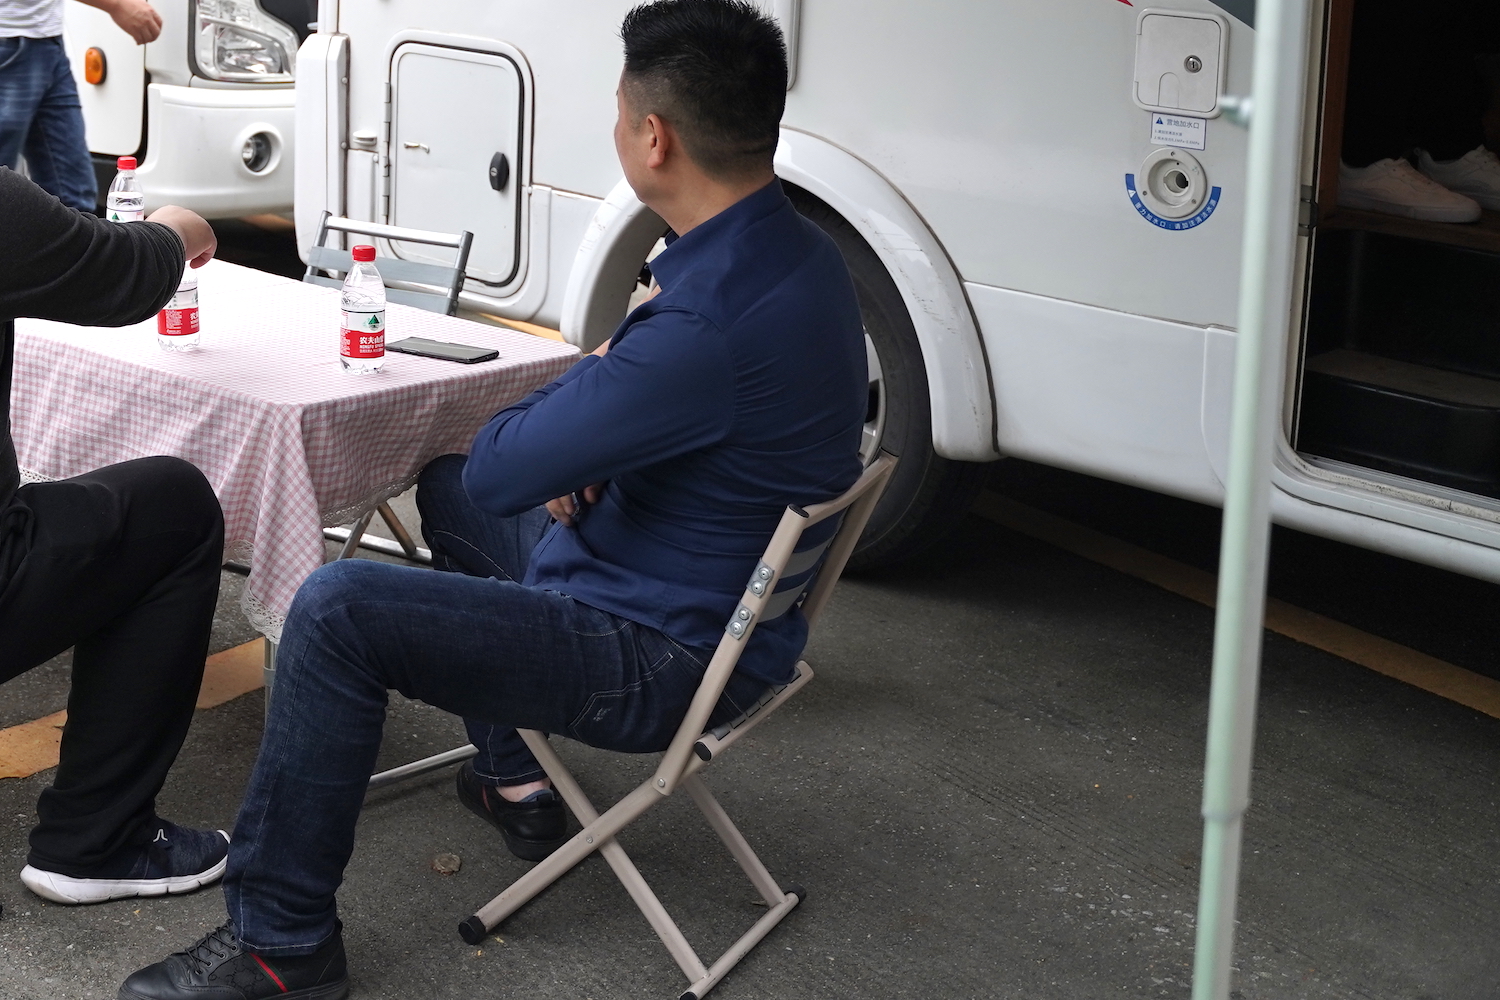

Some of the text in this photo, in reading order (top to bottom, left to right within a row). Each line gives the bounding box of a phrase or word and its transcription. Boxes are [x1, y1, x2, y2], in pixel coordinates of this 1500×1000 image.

[1166, 118, 1200, 130] 营地加水口
